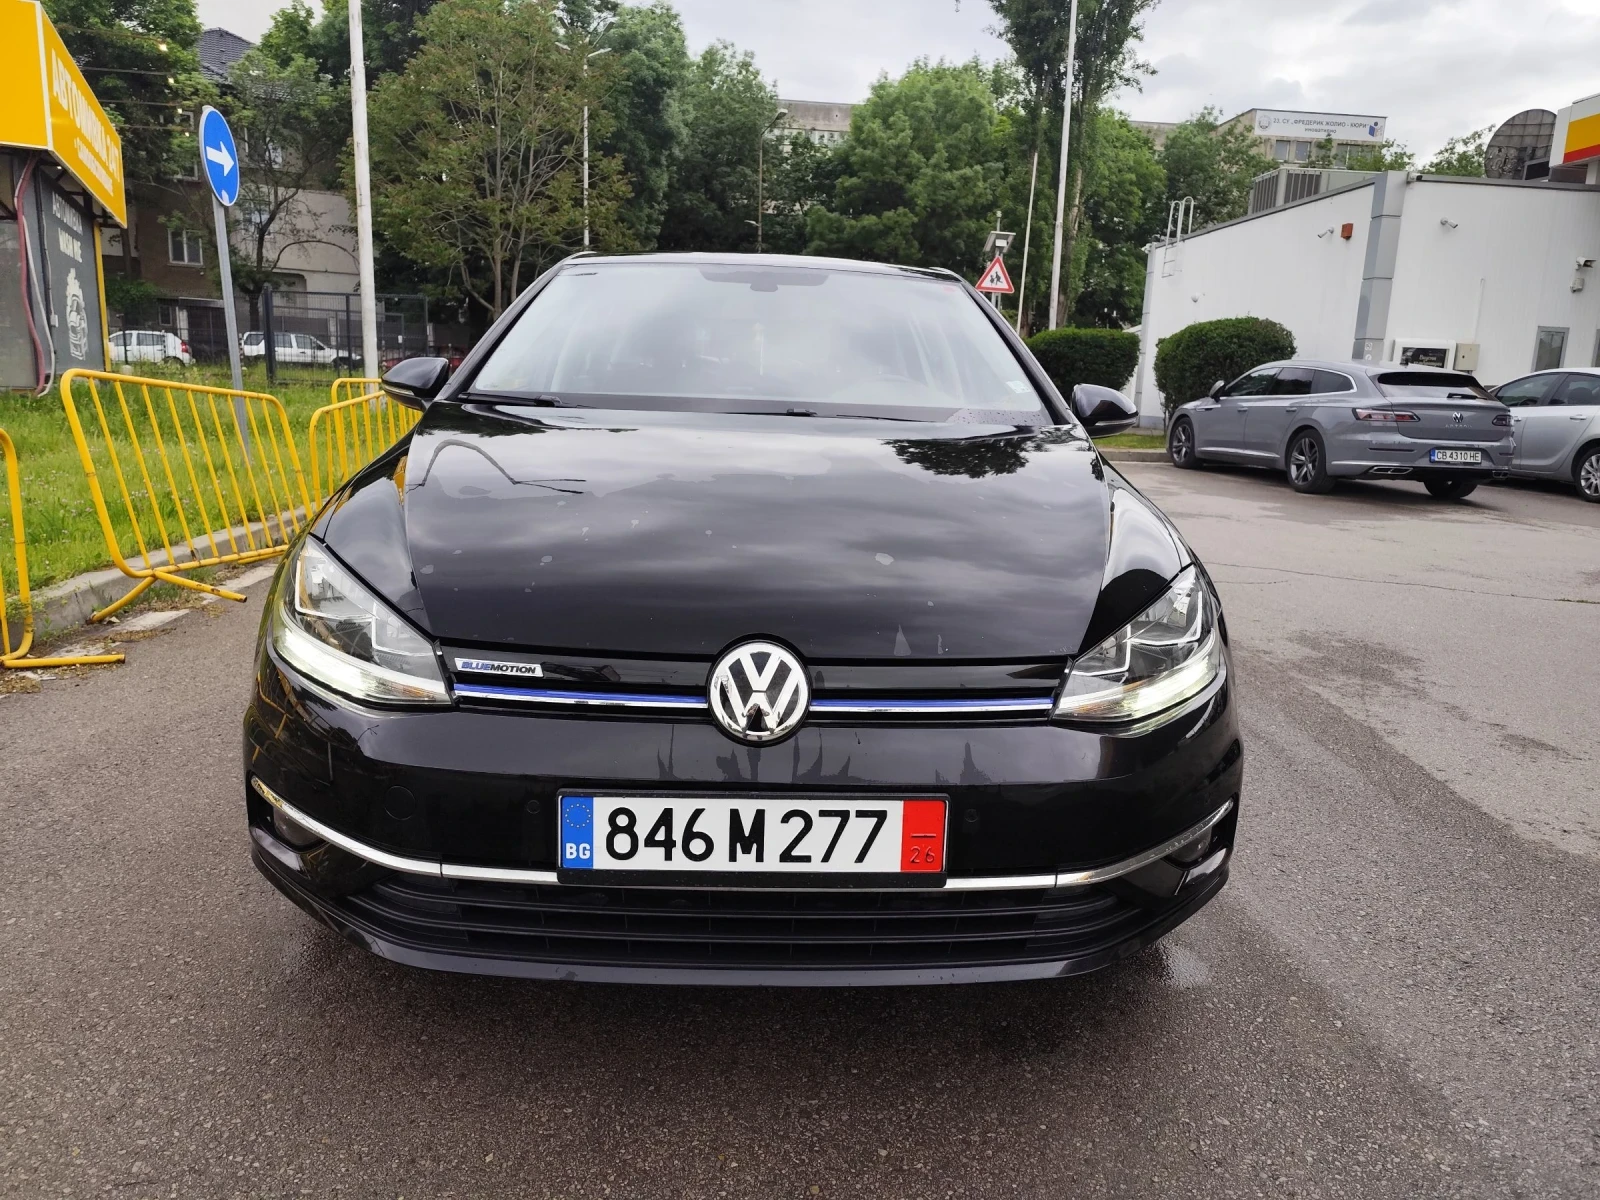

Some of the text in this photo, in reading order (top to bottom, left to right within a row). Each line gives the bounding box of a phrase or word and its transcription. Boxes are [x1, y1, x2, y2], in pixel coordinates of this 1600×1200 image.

[1436, 451, 1447, 460] CB
[1449, 451, 1468, 461] 4310
[1469, 452, 1480, 462] HE
[461, 661, 536, 674] BLUEMOTION
[605, 806, 888, 863] 846 M 277
[565, 842, 591, 859] BG
[910, 845, 936, 864] 26
